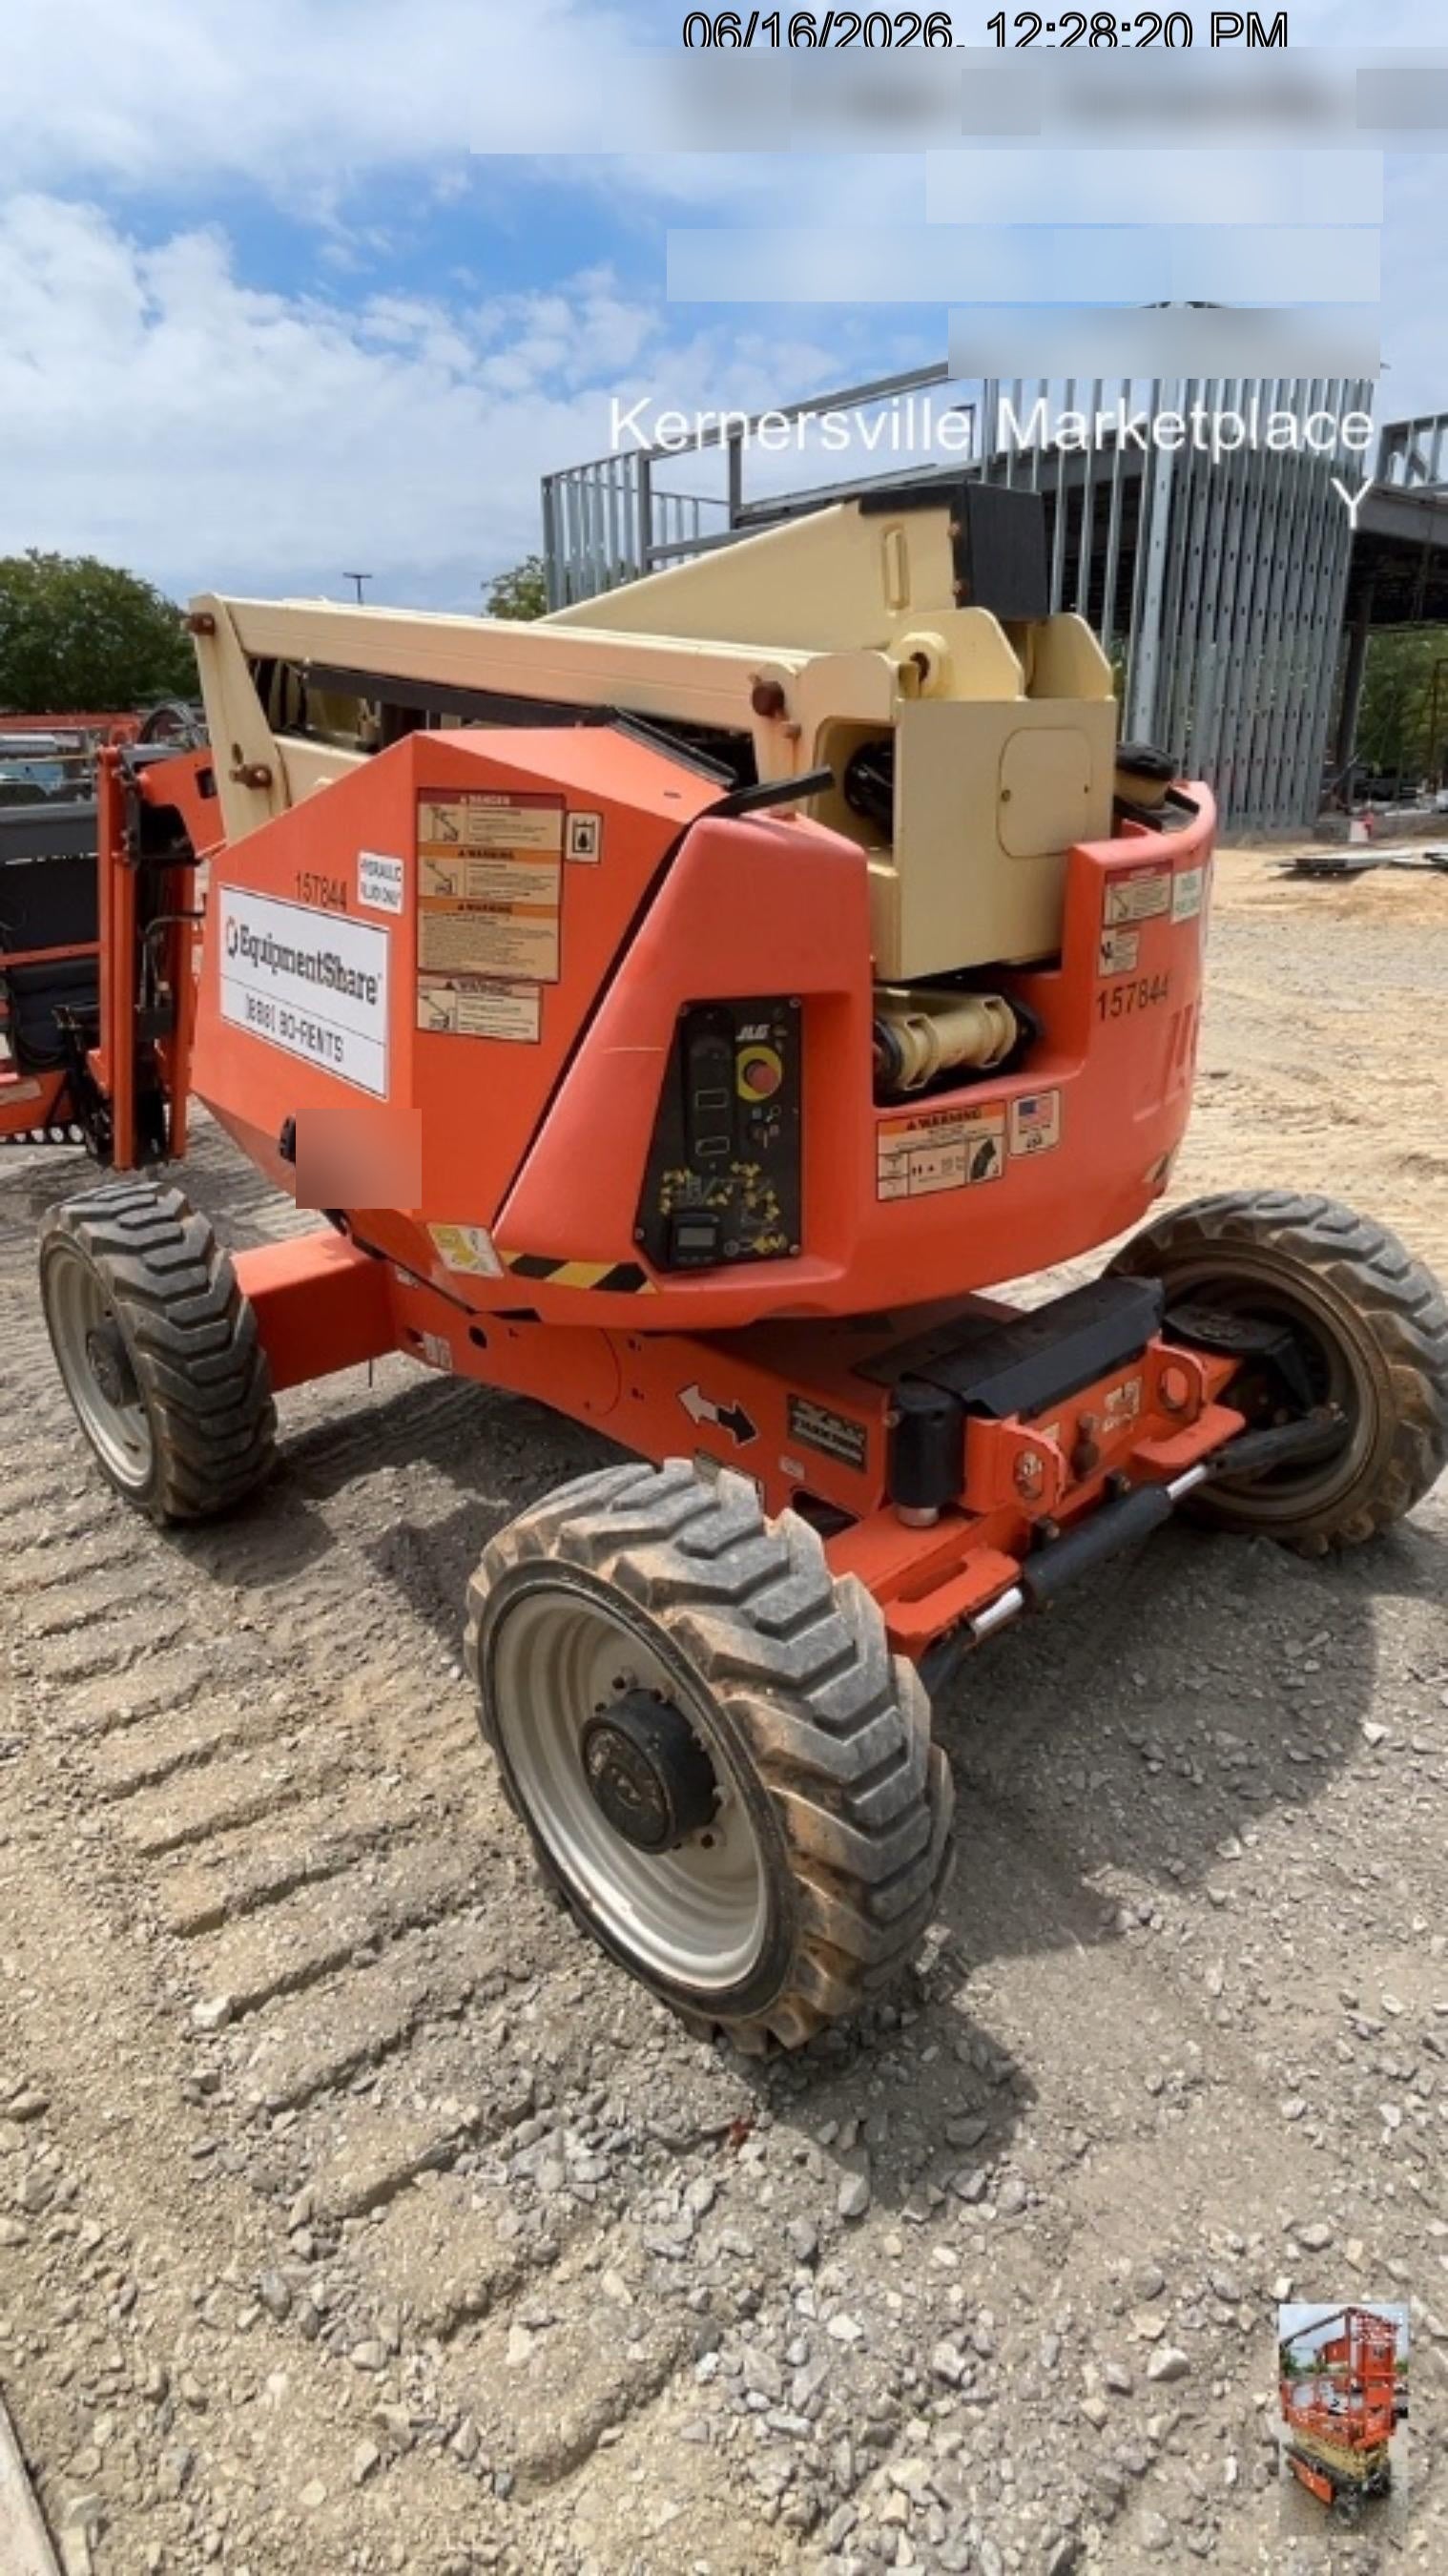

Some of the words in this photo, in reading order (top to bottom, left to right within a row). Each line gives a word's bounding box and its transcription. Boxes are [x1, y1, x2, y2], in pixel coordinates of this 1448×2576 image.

[296, 870, 347, 912] 157844
[240, 923, 377, 1005] EquipmentShare
[1098, 972, 1169, 1021] 157844
